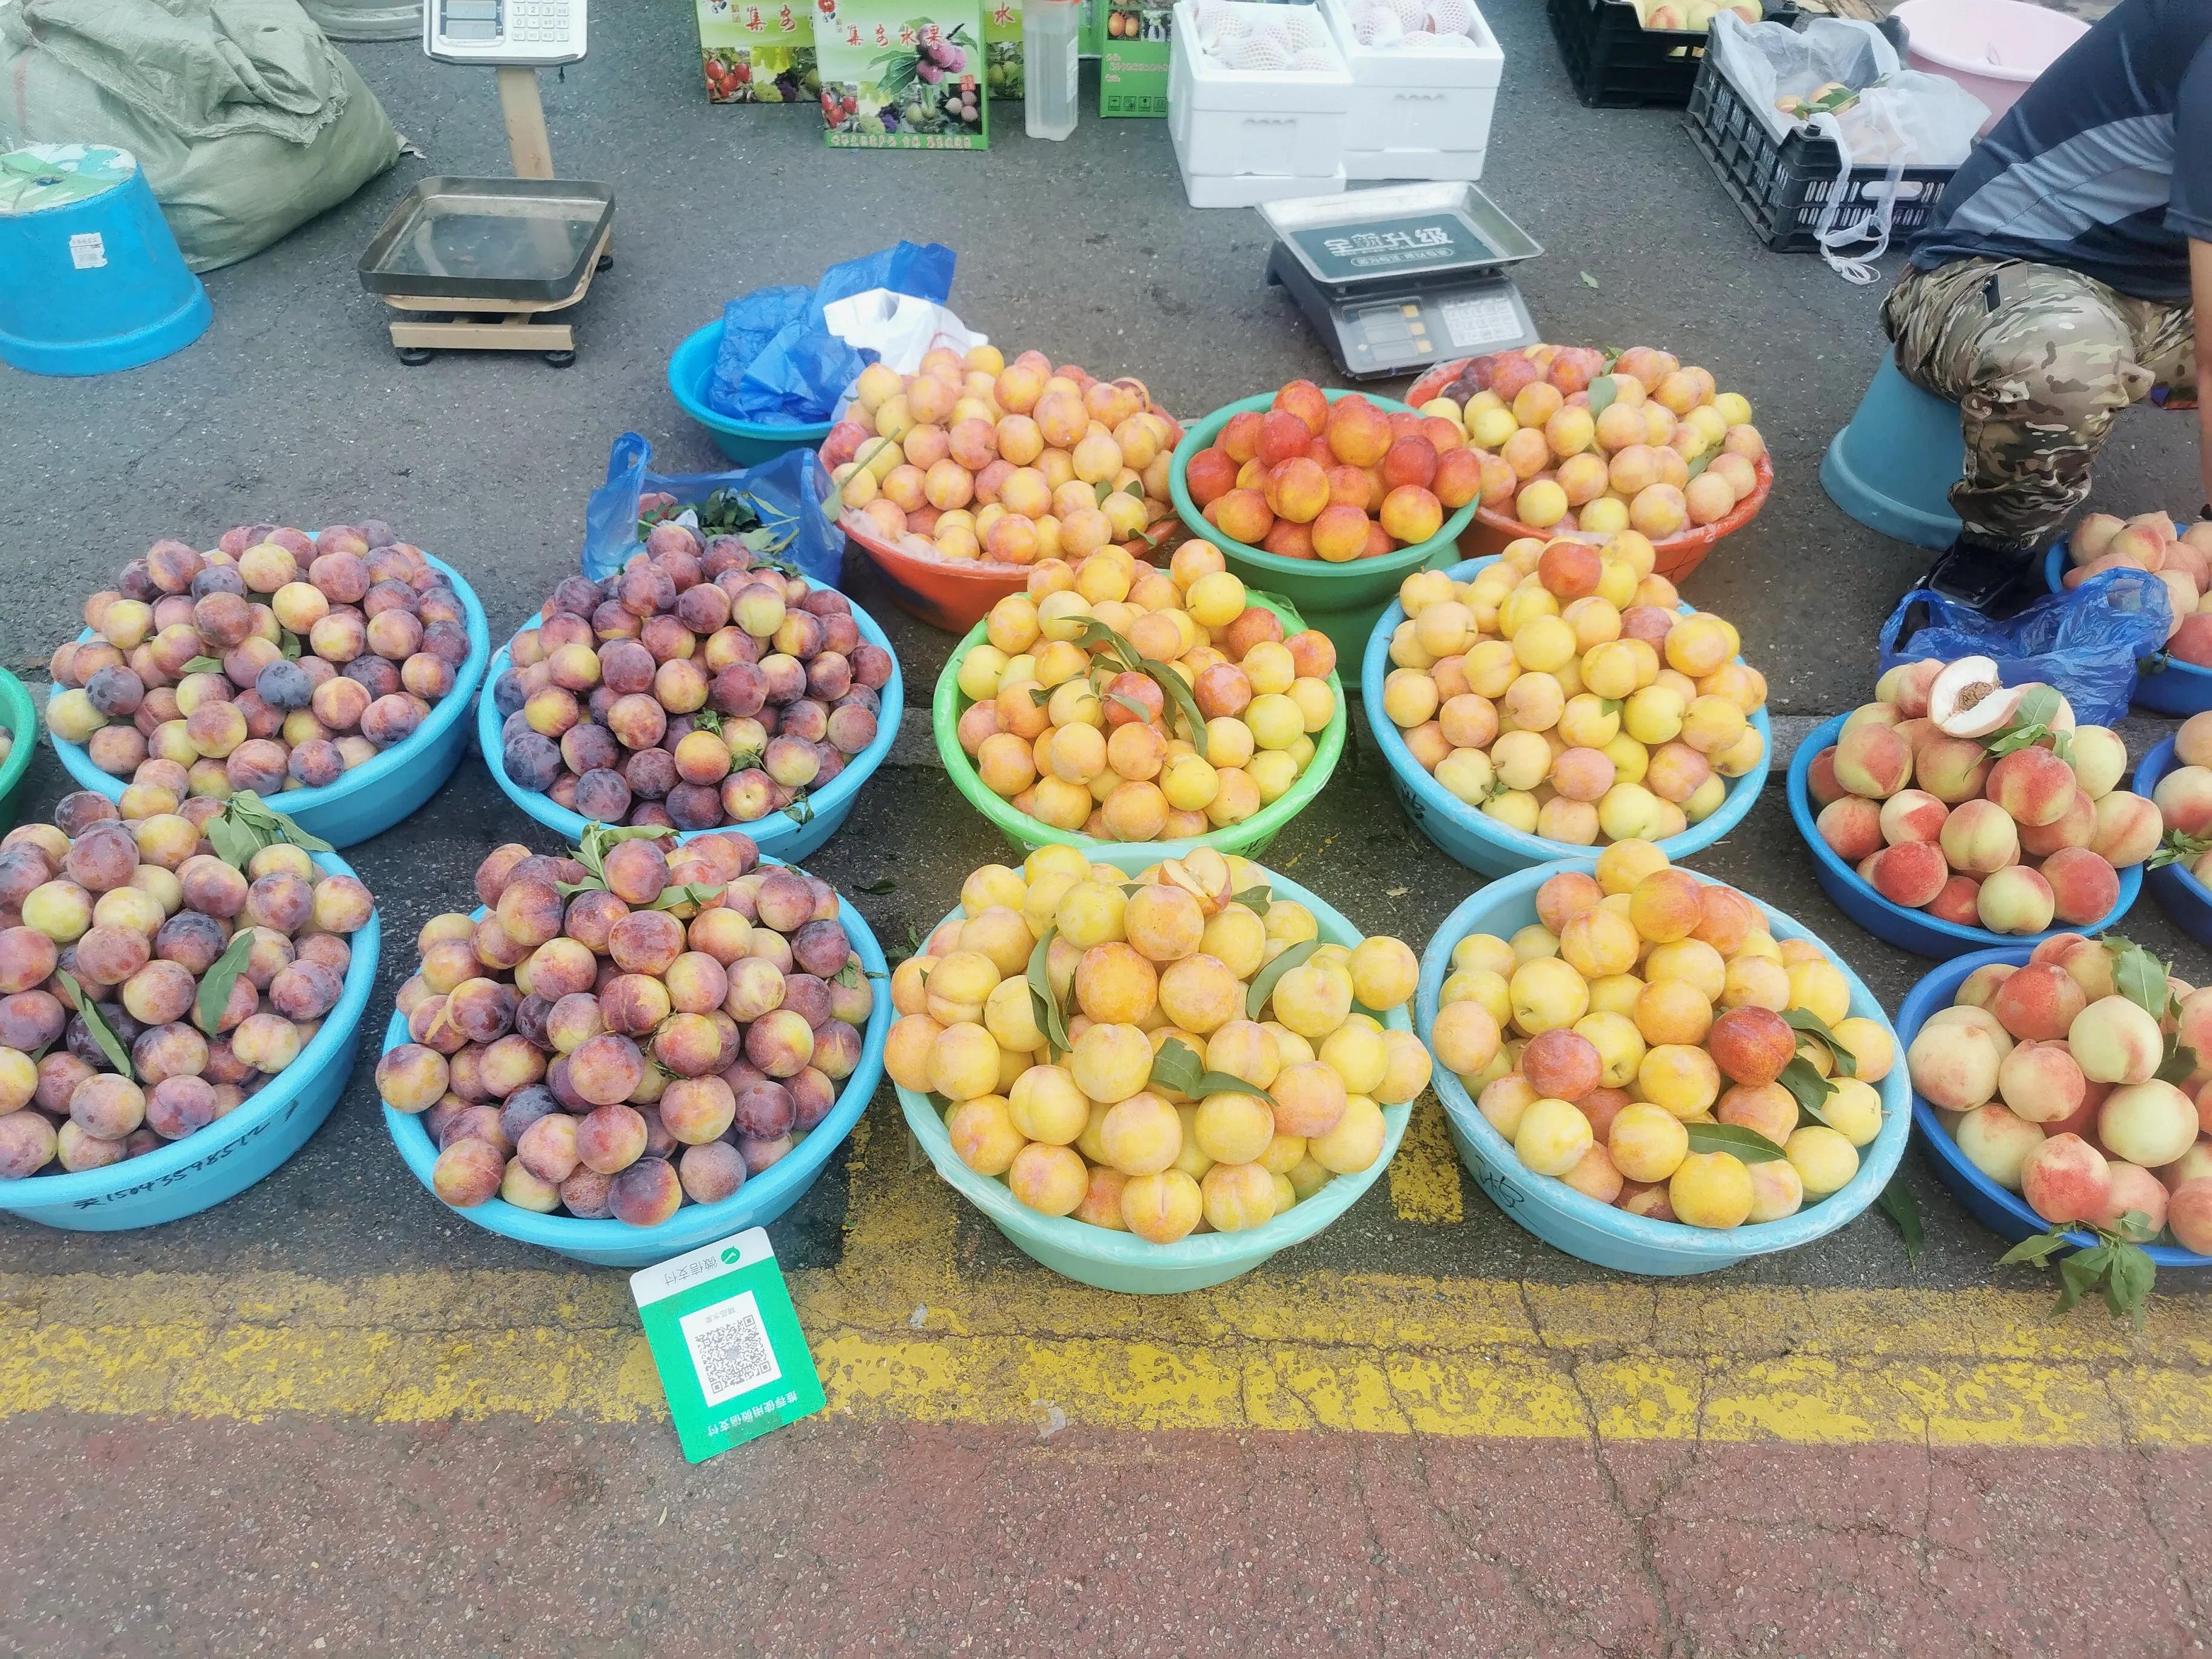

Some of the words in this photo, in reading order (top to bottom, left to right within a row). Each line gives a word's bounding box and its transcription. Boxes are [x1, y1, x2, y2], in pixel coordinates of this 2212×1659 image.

[994, 1, 1016, 27] 水
[1324, 227, 1455, 255] 全新升级
[663, 1255, 719, 1286] 微信支付
[704, 1305, 736, 1324] 精品水果
[706, 1389, 799, 1437] 推荐使用微信支付
